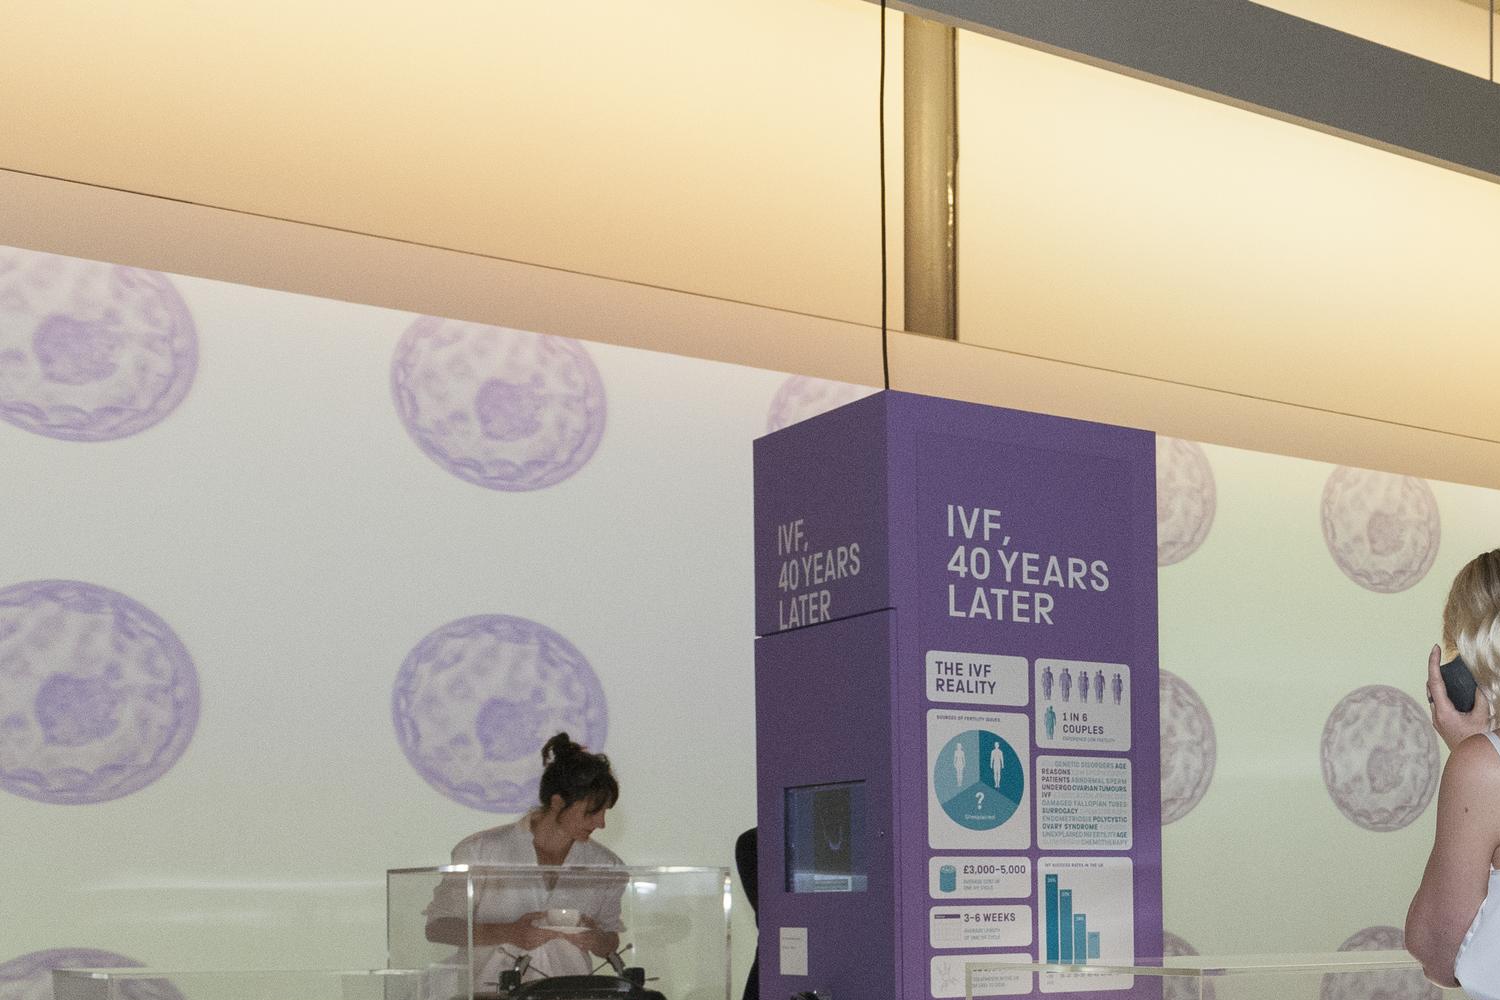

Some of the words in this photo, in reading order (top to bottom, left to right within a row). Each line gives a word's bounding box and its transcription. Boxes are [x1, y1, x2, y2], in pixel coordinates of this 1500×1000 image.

[778, 519, 809, 556] IVF,
[947, 504, 1011, 546] IVF,
[778, 559, 799, 592] 40
[802, 542, 861, 587] YEARS
[947, 545, 991, 580] 40
[997, 550, 1109, 592] YEARS
[780, 589, 831, 630] LATER
[948, 584, 1054, 625] LATER
[935, 660, 964, 677] THE
[968, 663, 992, 678] IVF
[935, 678, 997, 695] REALITY
[1062, 712, 1068, 722] 1
[1070, 713, 1080, 722] IN
[1081, 713, 1088, 722] 6
[1062, 724, 1104, 735] COUPLES
[1099, 785, 1127, 793] TUMOURS
[964, 913, 981, 923] 3-6
[982, 912, 1016, 922] WEEKS
